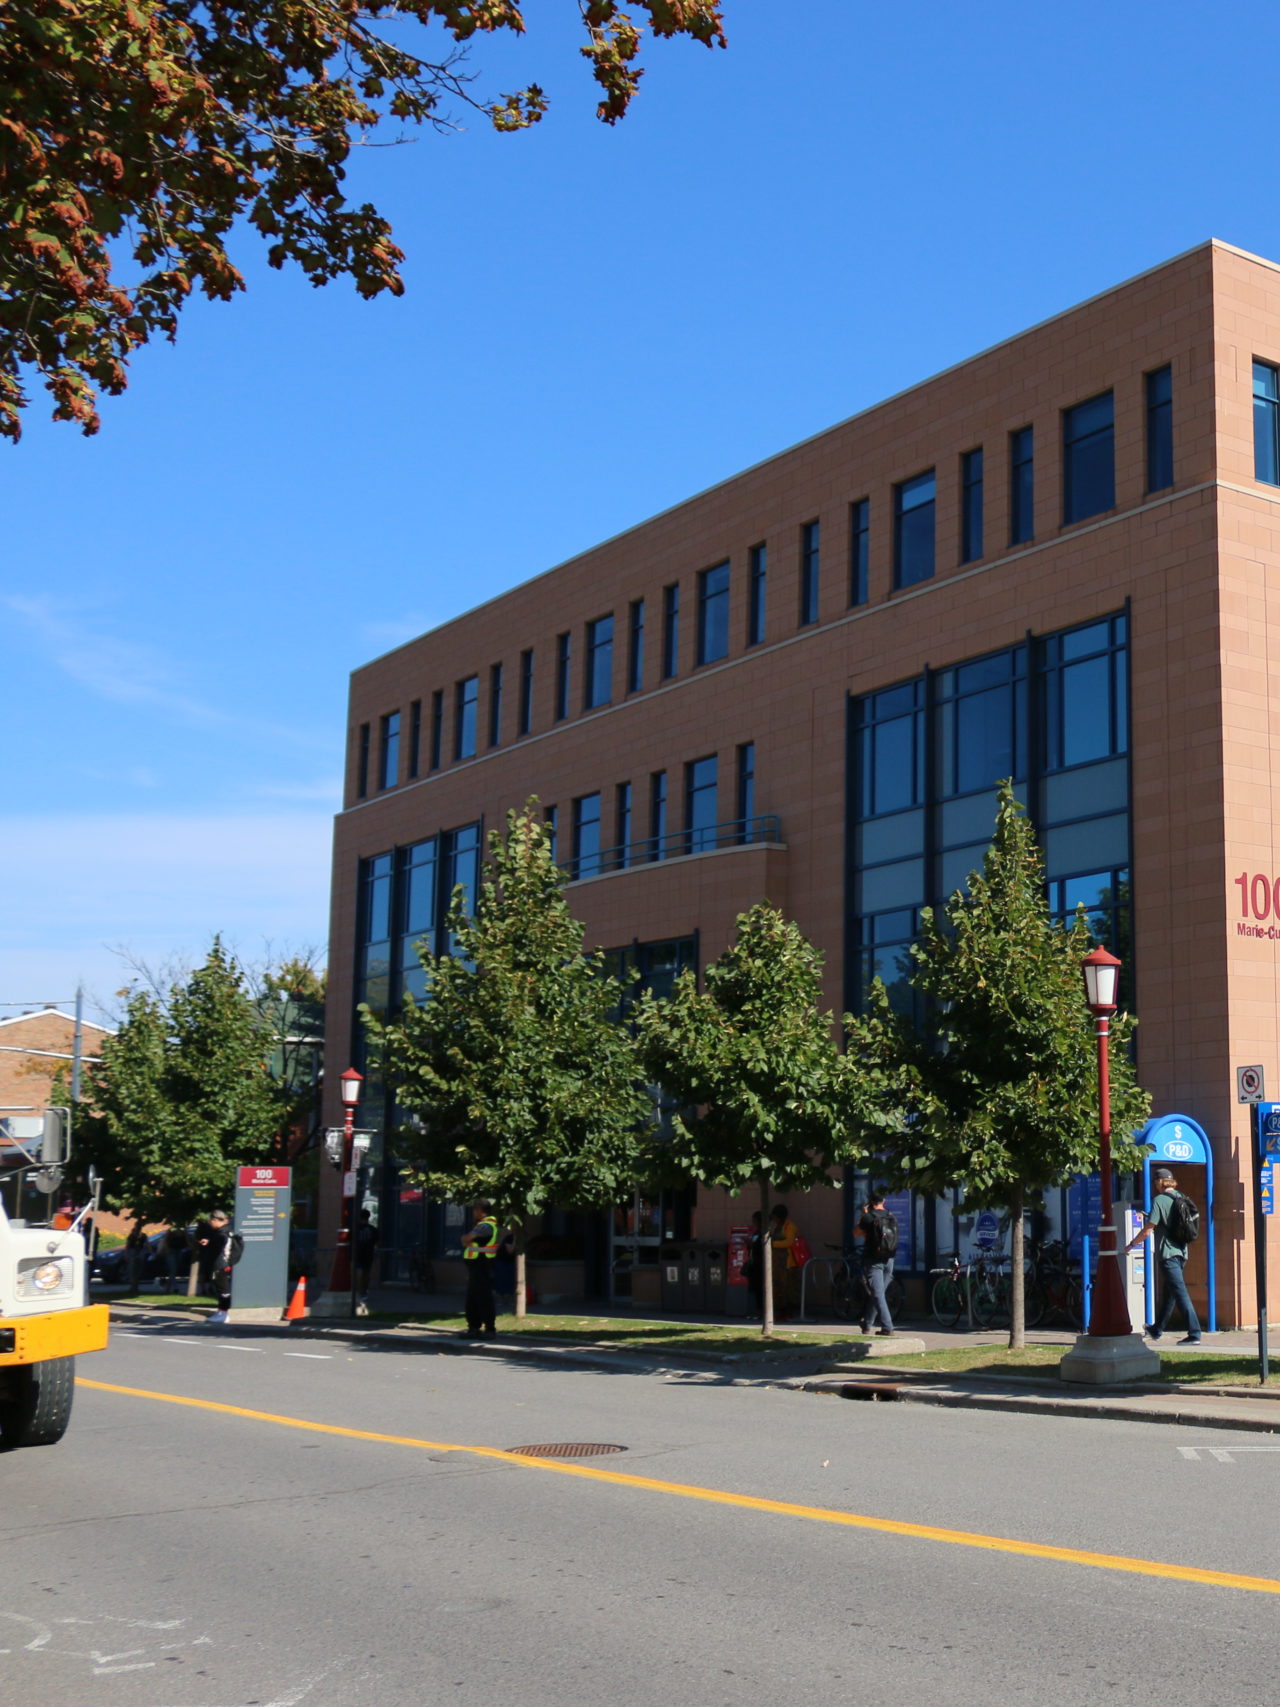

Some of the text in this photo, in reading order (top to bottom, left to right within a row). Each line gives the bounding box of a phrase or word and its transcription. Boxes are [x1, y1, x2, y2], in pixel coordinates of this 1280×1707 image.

[1174, 1125, 1182, 1139] $
[1169, 1143, 1189, 1157] P&D
[255, 1169, 273, 1179] 100
